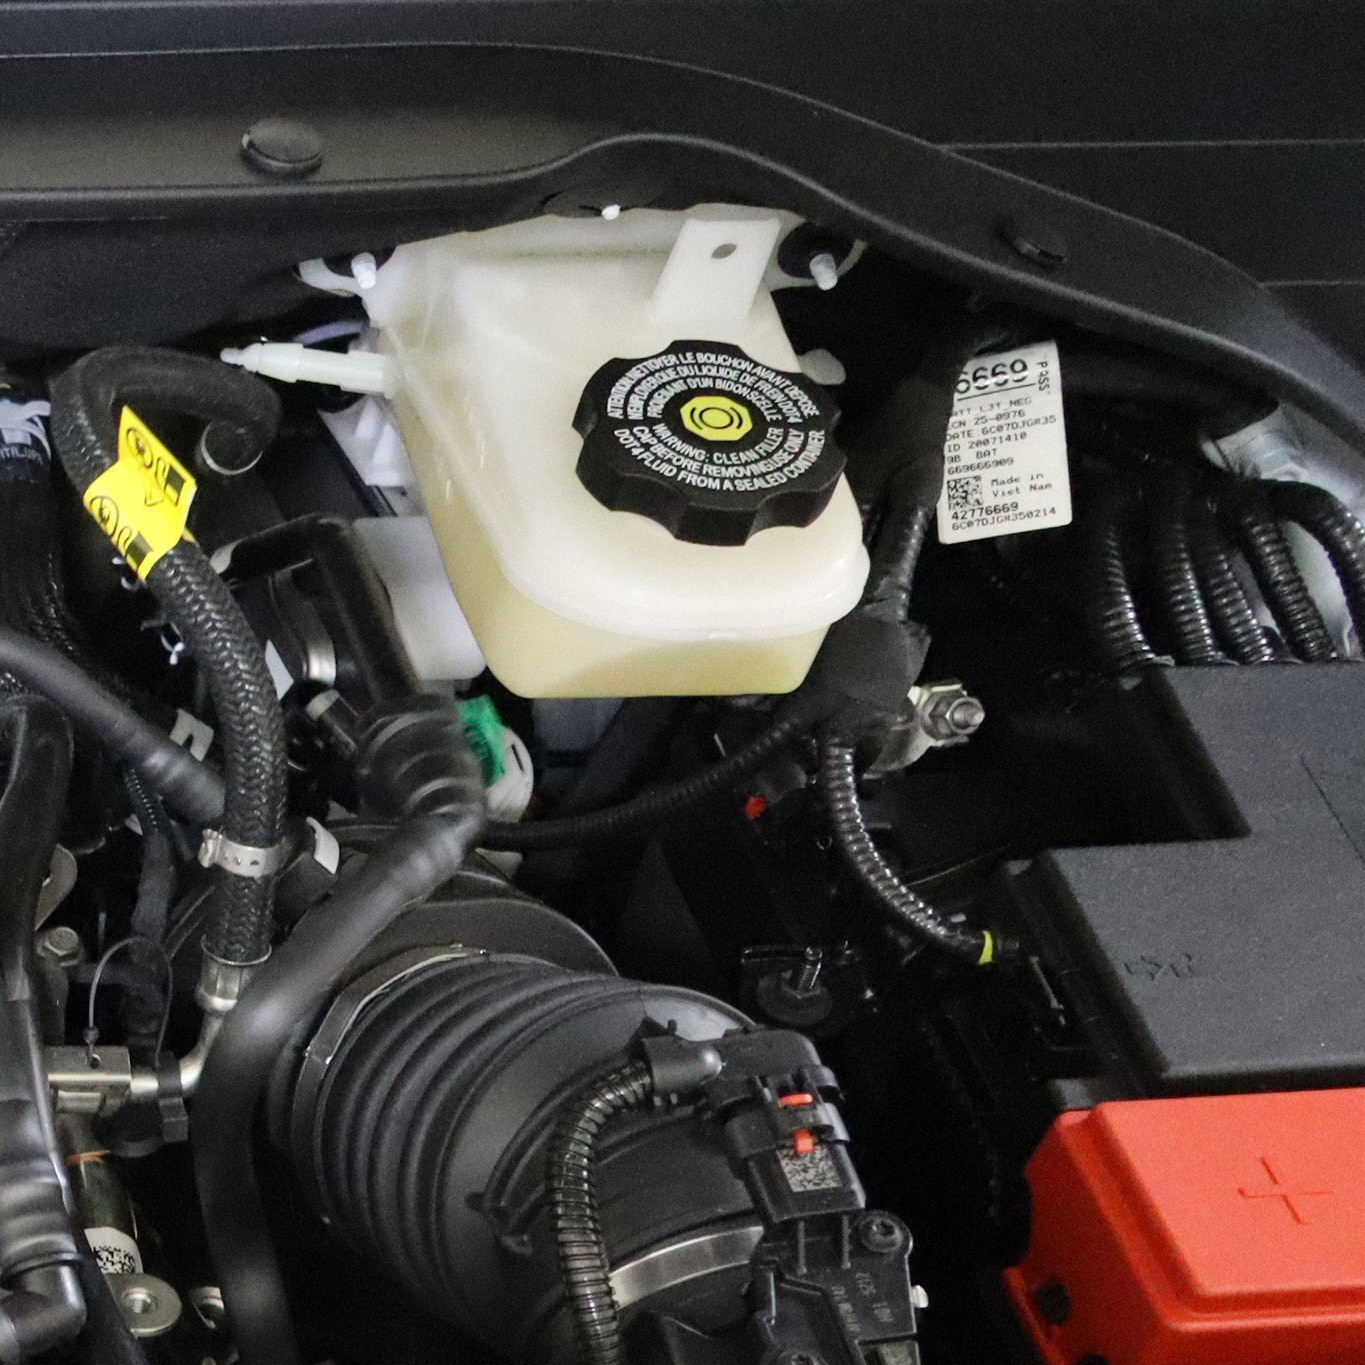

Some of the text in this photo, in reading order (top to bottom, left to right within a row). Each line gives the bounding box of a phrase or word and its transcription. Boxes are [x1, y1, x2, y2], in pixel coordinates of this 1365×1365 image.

[677, 366, 695, 376] DU
[694, 364, 741, 380] LIQUIDE
[739, 372, 759, 386] DE
[753, 380, 788, 405] FREIN
[678, 352, 697, 364] LE
[696, 352, 754, 371] BOUCHON
[752, 366, 791, 388] AVANT
[715, 378, 750, 397] BIDON
[746, 390, 782, 422] SCELLE
[633, 426, 658, 445] CAP
[650, 443, 703, 473] BEFORE
[783, 428, 805, 453] ONLY
[652, 423, 784, 464] WARNING: CLEAN FILLER
[947, 429, 973, 441] DATE
[637, 451, 677, 477] FLUID
[677, 470, 720, 490] FROM
[722, 478, 734, 491] A
[734, 470, 788, 491] SEALED
[976, 448, 997, 459] BAT
[991, 473, 1044, 486] Made in
[992, 483, 1053, 497] Viet Nam
[951, 502, 1019, 520] 42776669
